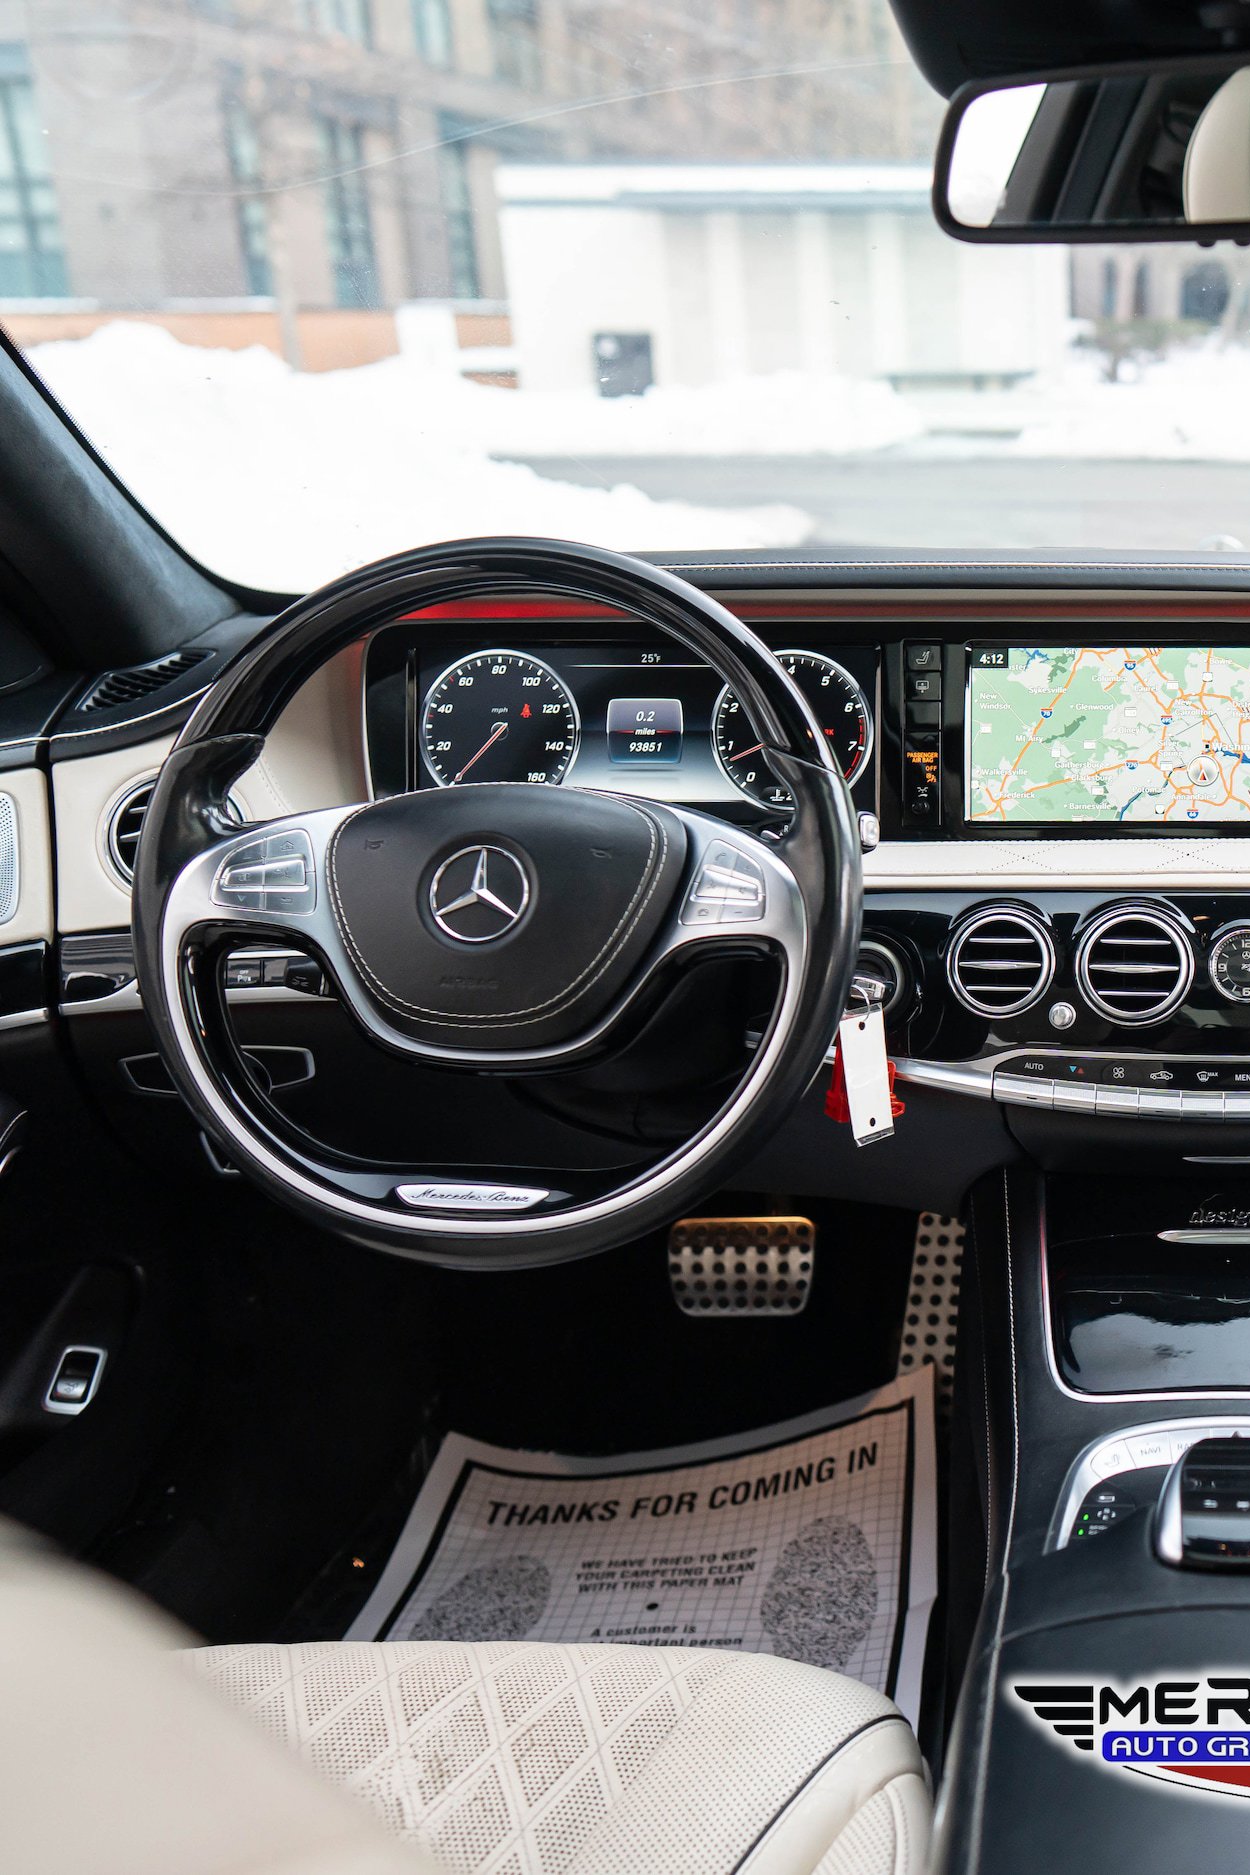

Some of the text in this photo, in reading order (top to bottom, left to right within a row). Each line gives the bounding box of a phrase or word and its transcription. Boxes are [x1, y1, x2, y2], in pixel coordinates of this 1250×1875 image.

[980, 653, 1004, 664] 4:12
[491, 665, 507, 675] 80
[787, 664, 796, 675] 4
[458, 677, 474, 687] 60
[522, 677, 541, 687] 100
[821, 676, 831, 686] 5
[437, 704, 453, 714] 40
[491, 707, 508, 715] mph
[542, 704, 561, 714] 120
[729, 702, 739, 713] 2
[844, 703, 854, 713] 6
[1075, 703, 1114, 711] Glenwood
[635, 711, 656, 722] 0.2
[634, 728, 656, 736] miles
[436, 741, 452, 751] 20
[545, 741, 564, 751] 140
[629, 742, 663, 753] 93851
[727, 740, 734, 751] 1
[847, 740, 857, 751] 7
[527, 772, 546, 782] 160
[746, 771, 756, 782] 0
[1069, 802, 1111, 810] Barnesville
[1218, 963, 1227, 972] 9
[1242, 987, 1250, 997] 6
[1024, 1061, 1044, 1071] AUTO
[487, 1441, 878, 1527] THANKS FOR COMING IN
[581, 1547, 758, 1570] WE HAVE TRIED TO KEEP
[576, 1561, 756, 1581] YOUR CARPETING CLEAN
[577, 1575, 745, 1594] WITH THIS PAPER MAT
[590, 1624, 697, 1637] A customer is
[689, 1636, 744, 1648] person
